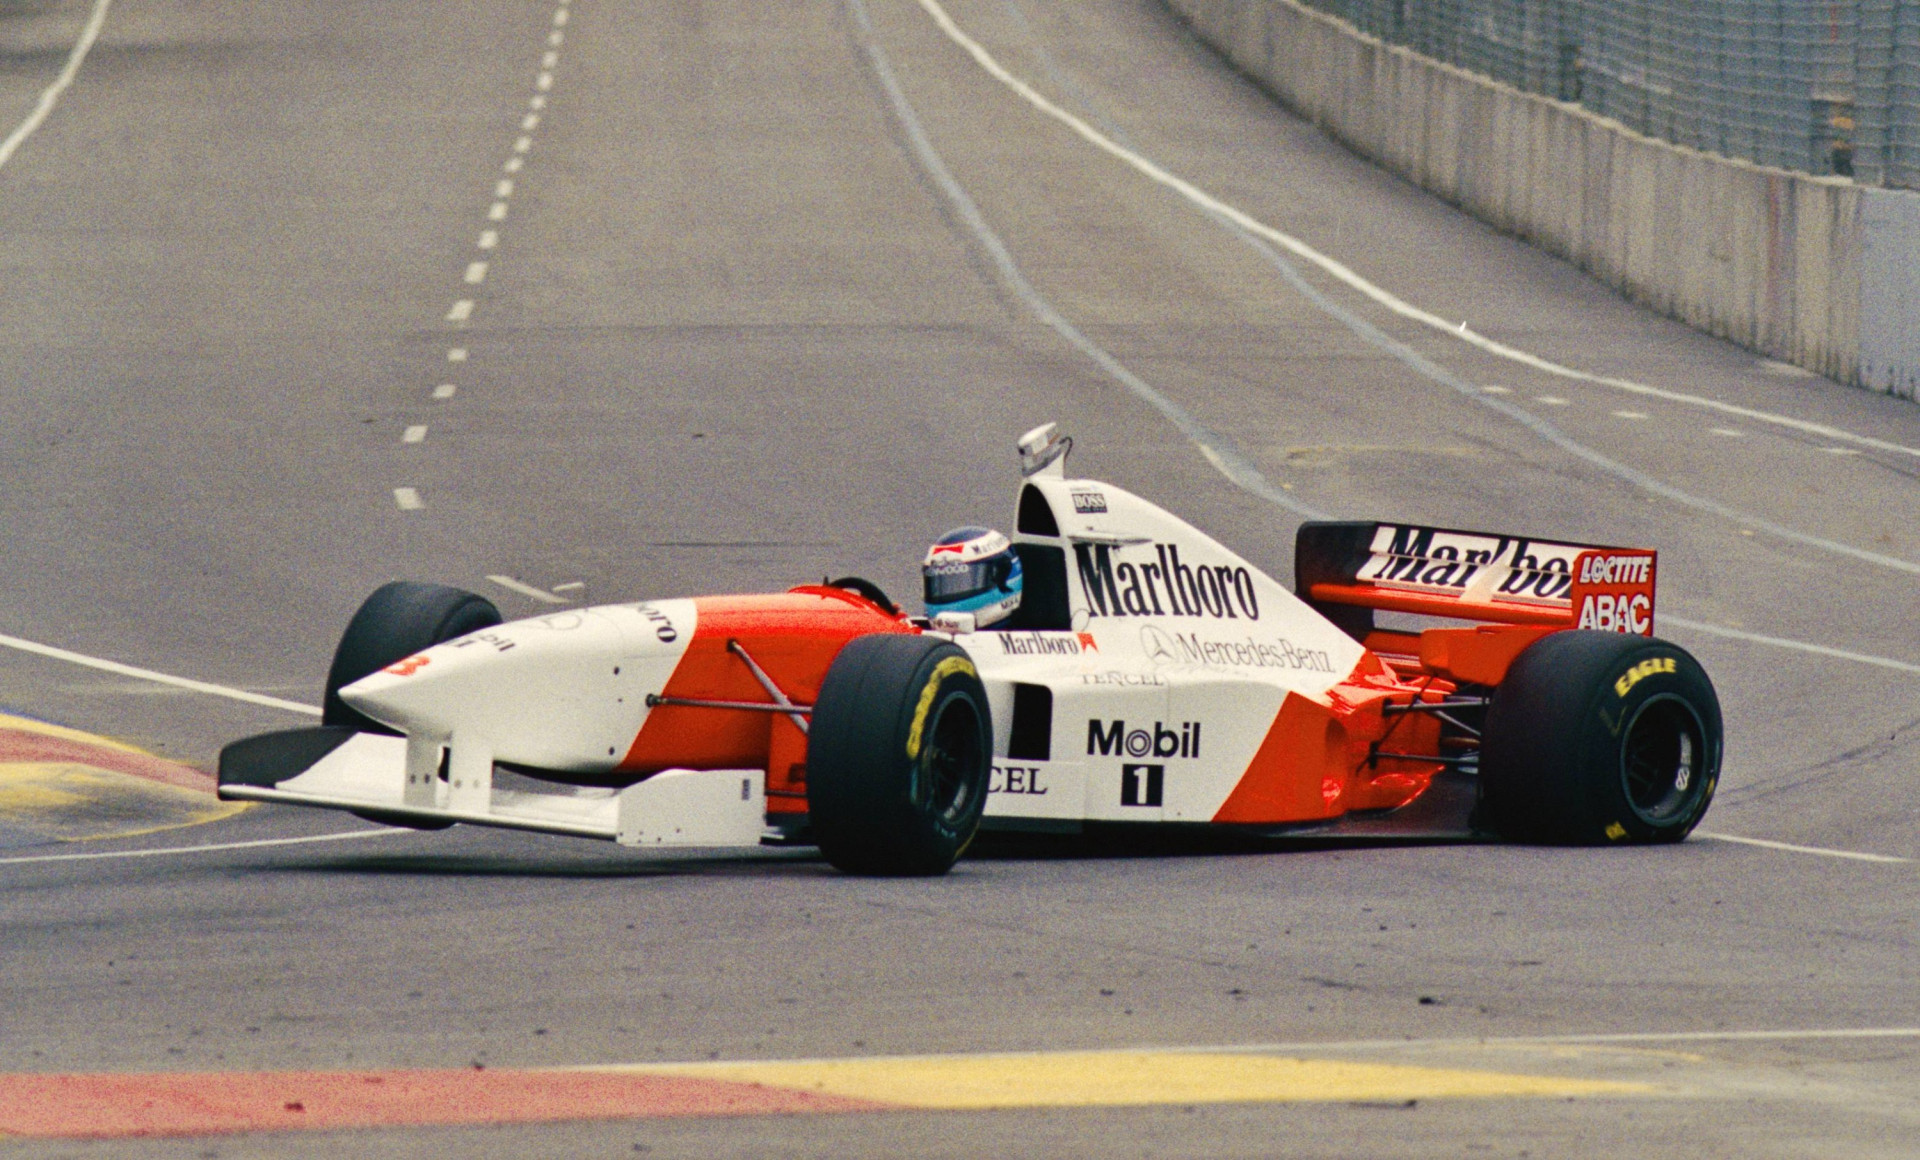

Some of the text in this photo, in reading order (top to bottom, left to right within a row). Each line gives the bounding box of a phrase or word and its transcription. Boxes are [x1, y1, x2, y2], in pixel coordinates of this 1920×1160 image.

[1072, 543, 1260, 620] Marlboro
[1580, 556, 1652, 584] LOCTITE
[1579, 594, 1650, 634] ABAC
[998, 630, 1079, 655] Marlboro
[1176, 632, 1336, 673] Mercedes-Benz
[1614, 657, 1676, 698] EAGLE
[1087, 719, 1201, 759] Mobil
[1132, 766, 1150, 806] 1
